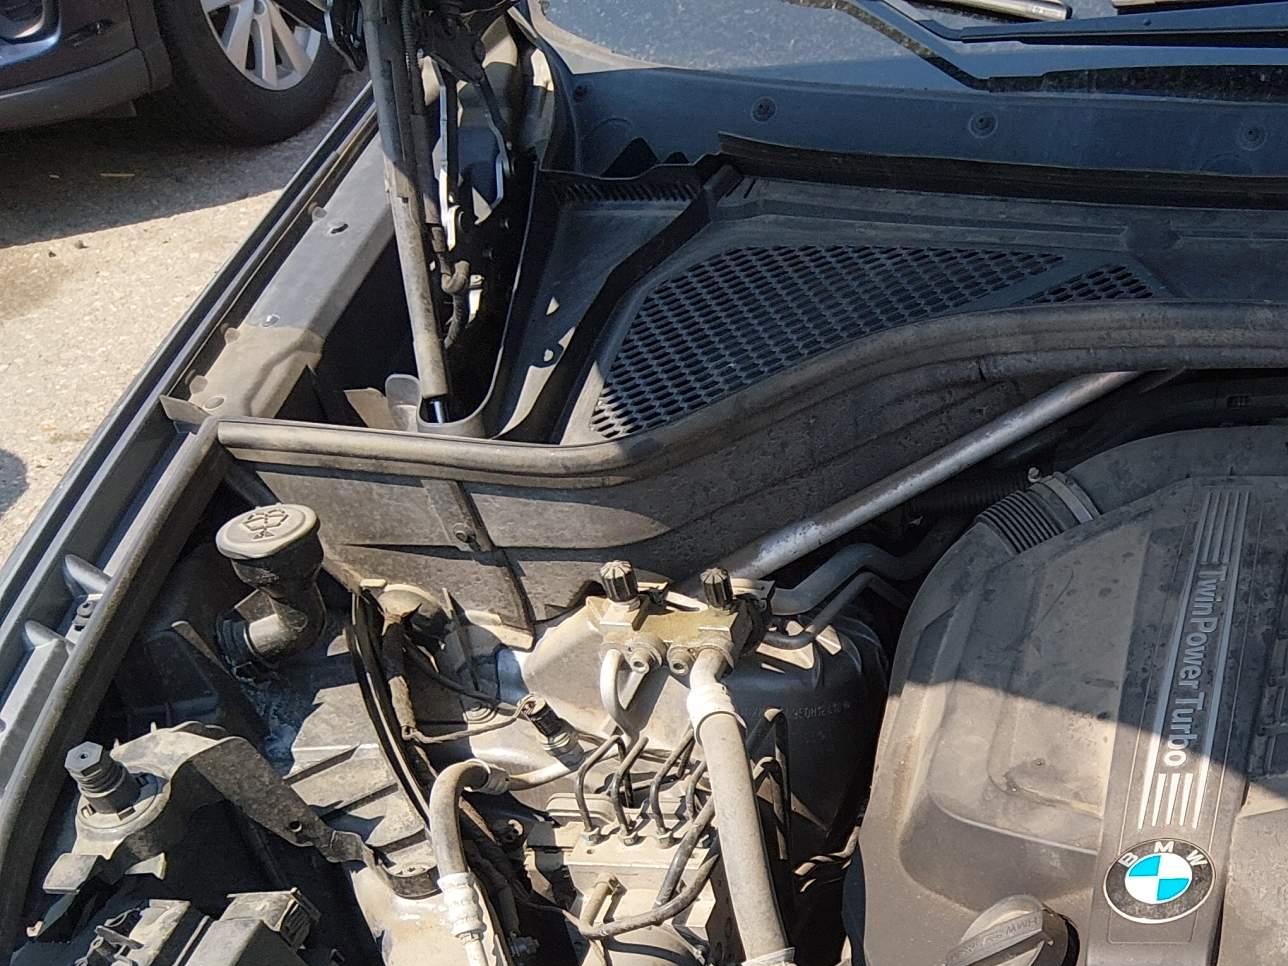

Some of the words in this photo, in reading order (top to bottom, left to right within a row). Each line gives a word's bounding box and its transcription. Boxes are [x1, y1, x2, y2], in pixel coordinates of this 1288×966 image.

[1178, 563, 1228, 690] TwinPower
[1163, 691, 1206, 767] Turbo
[1118, 841, 1209, 868] BMW
